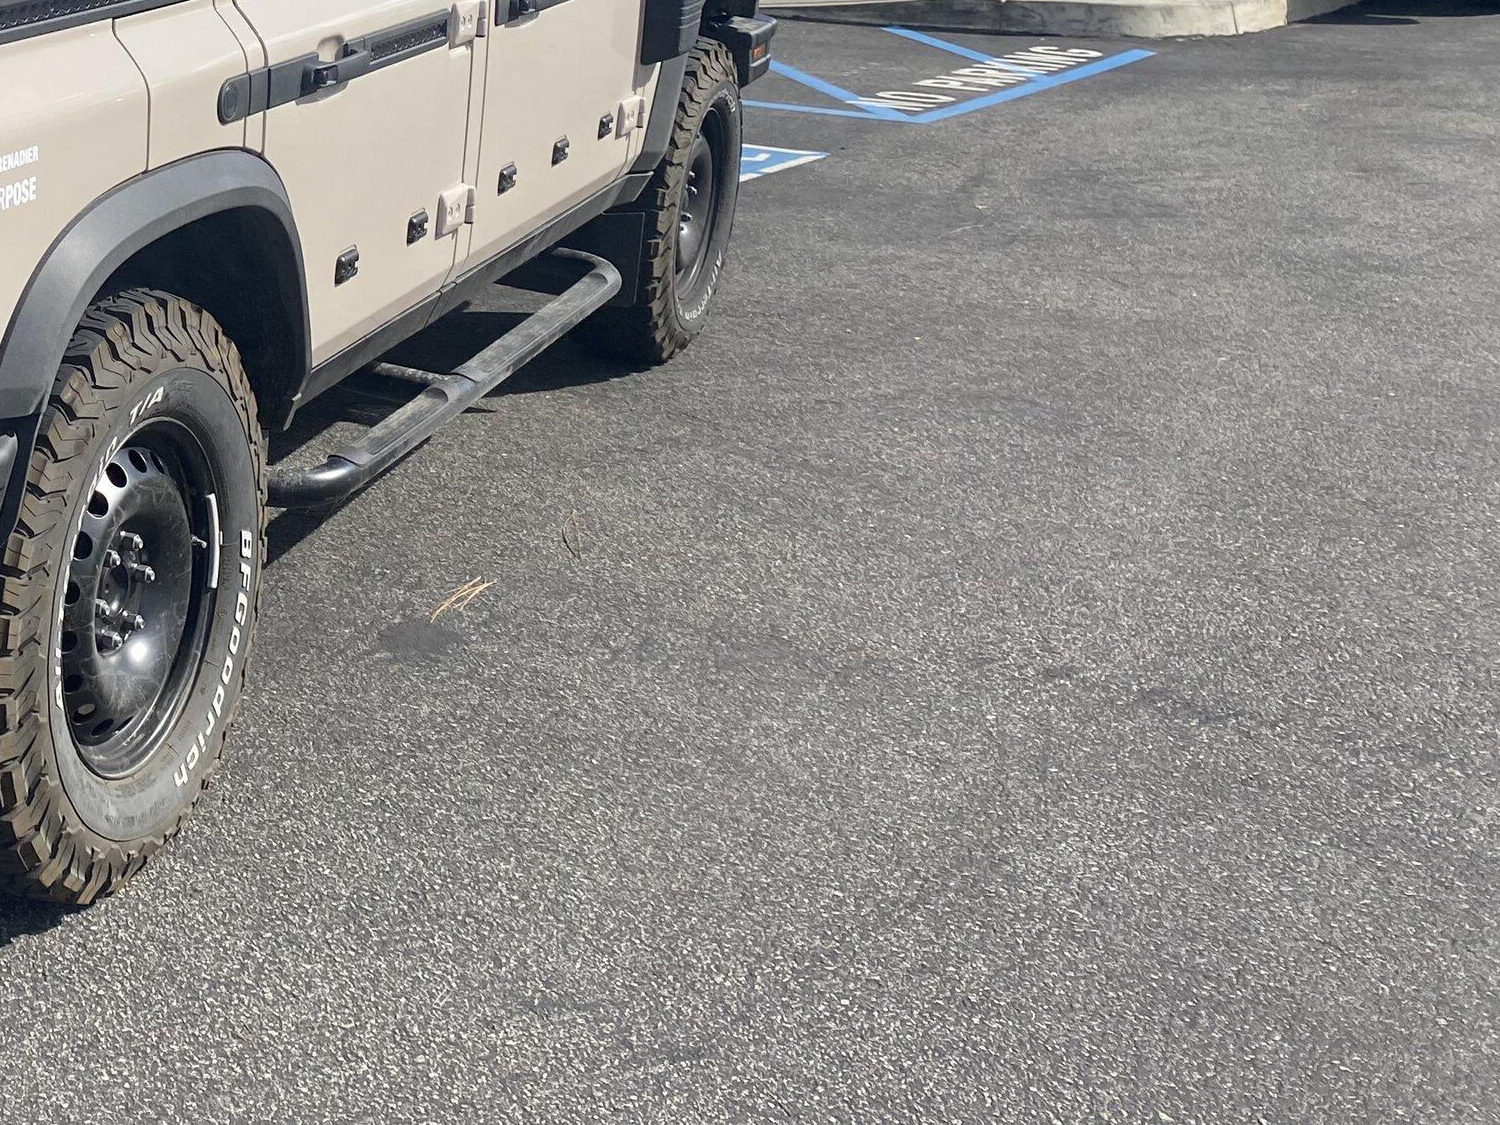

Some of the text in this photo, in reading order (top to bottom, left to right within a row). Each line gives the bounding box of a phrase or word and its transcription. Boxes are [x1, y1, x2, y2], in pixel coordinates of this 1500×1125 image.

[845, 45, 1103, 112] NO PARKING
[173, 529, 253, 788] BFGoodrich
